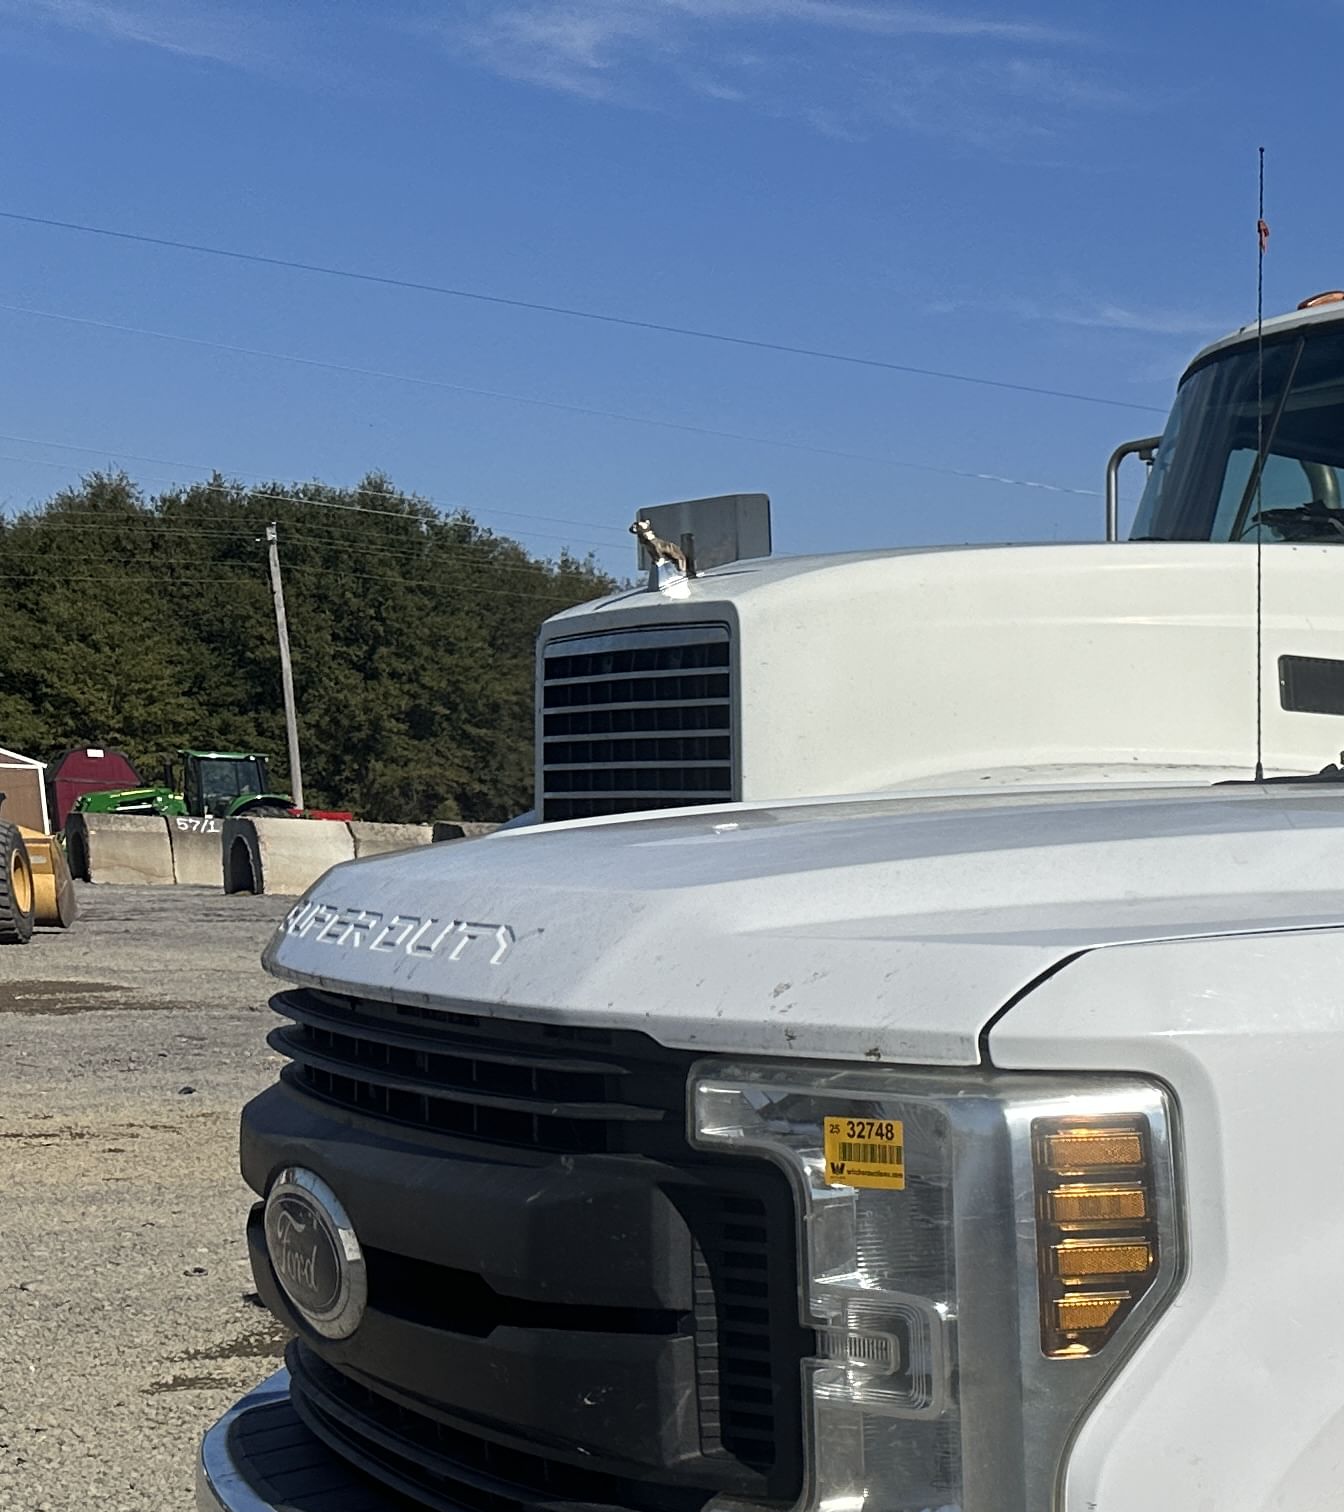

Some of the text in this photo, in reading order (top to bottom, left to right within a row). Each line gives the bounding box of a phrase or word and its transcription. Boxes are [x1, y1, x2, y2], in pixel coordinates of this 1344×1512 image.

[369, 915, 517, 965] DUTY
[846, 1120, 895, 1141] 32748
[277, 1209, 321, 1293] Ford
